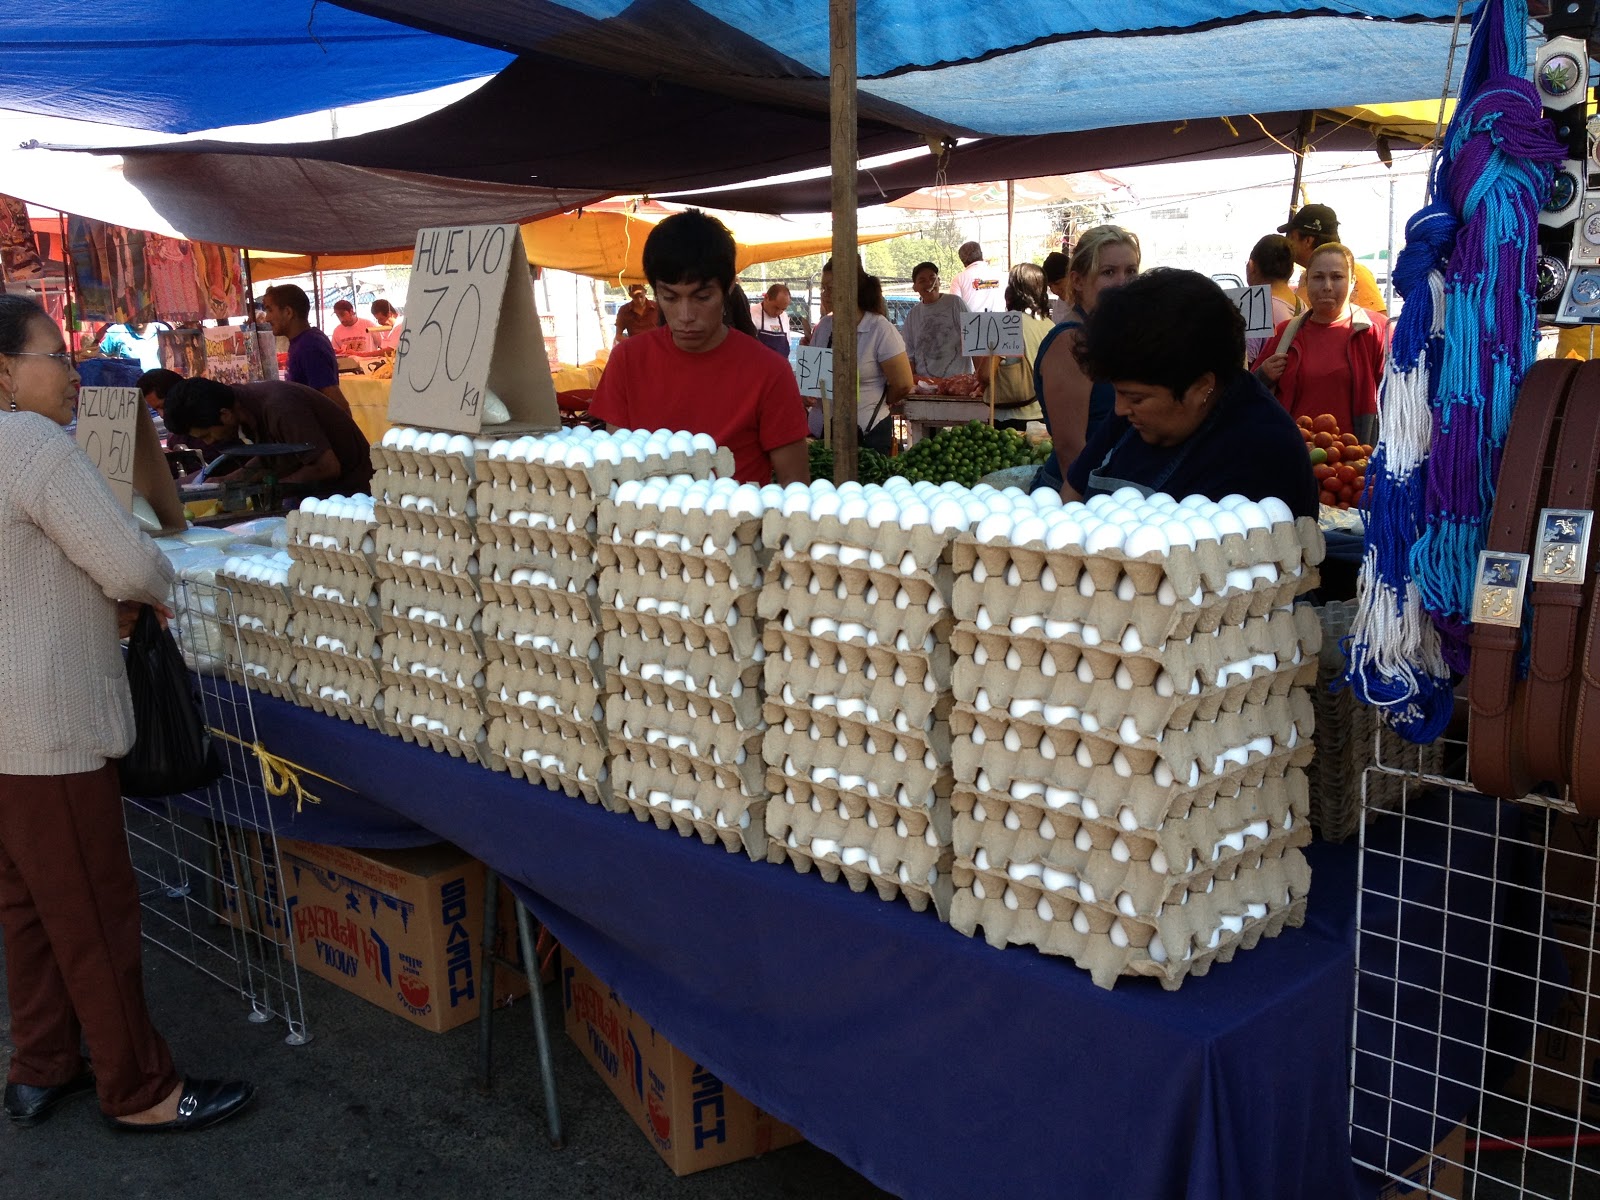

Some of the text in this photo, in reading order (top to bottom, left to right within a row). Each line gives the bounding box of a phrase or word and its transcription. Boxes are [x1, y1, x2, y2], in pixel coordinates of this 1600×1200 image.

[416, 227, 505, 275] HUEVO
[315, 938, 359, 978] AVICOLA
[441, 877, 475, 1008] HUEVOS
